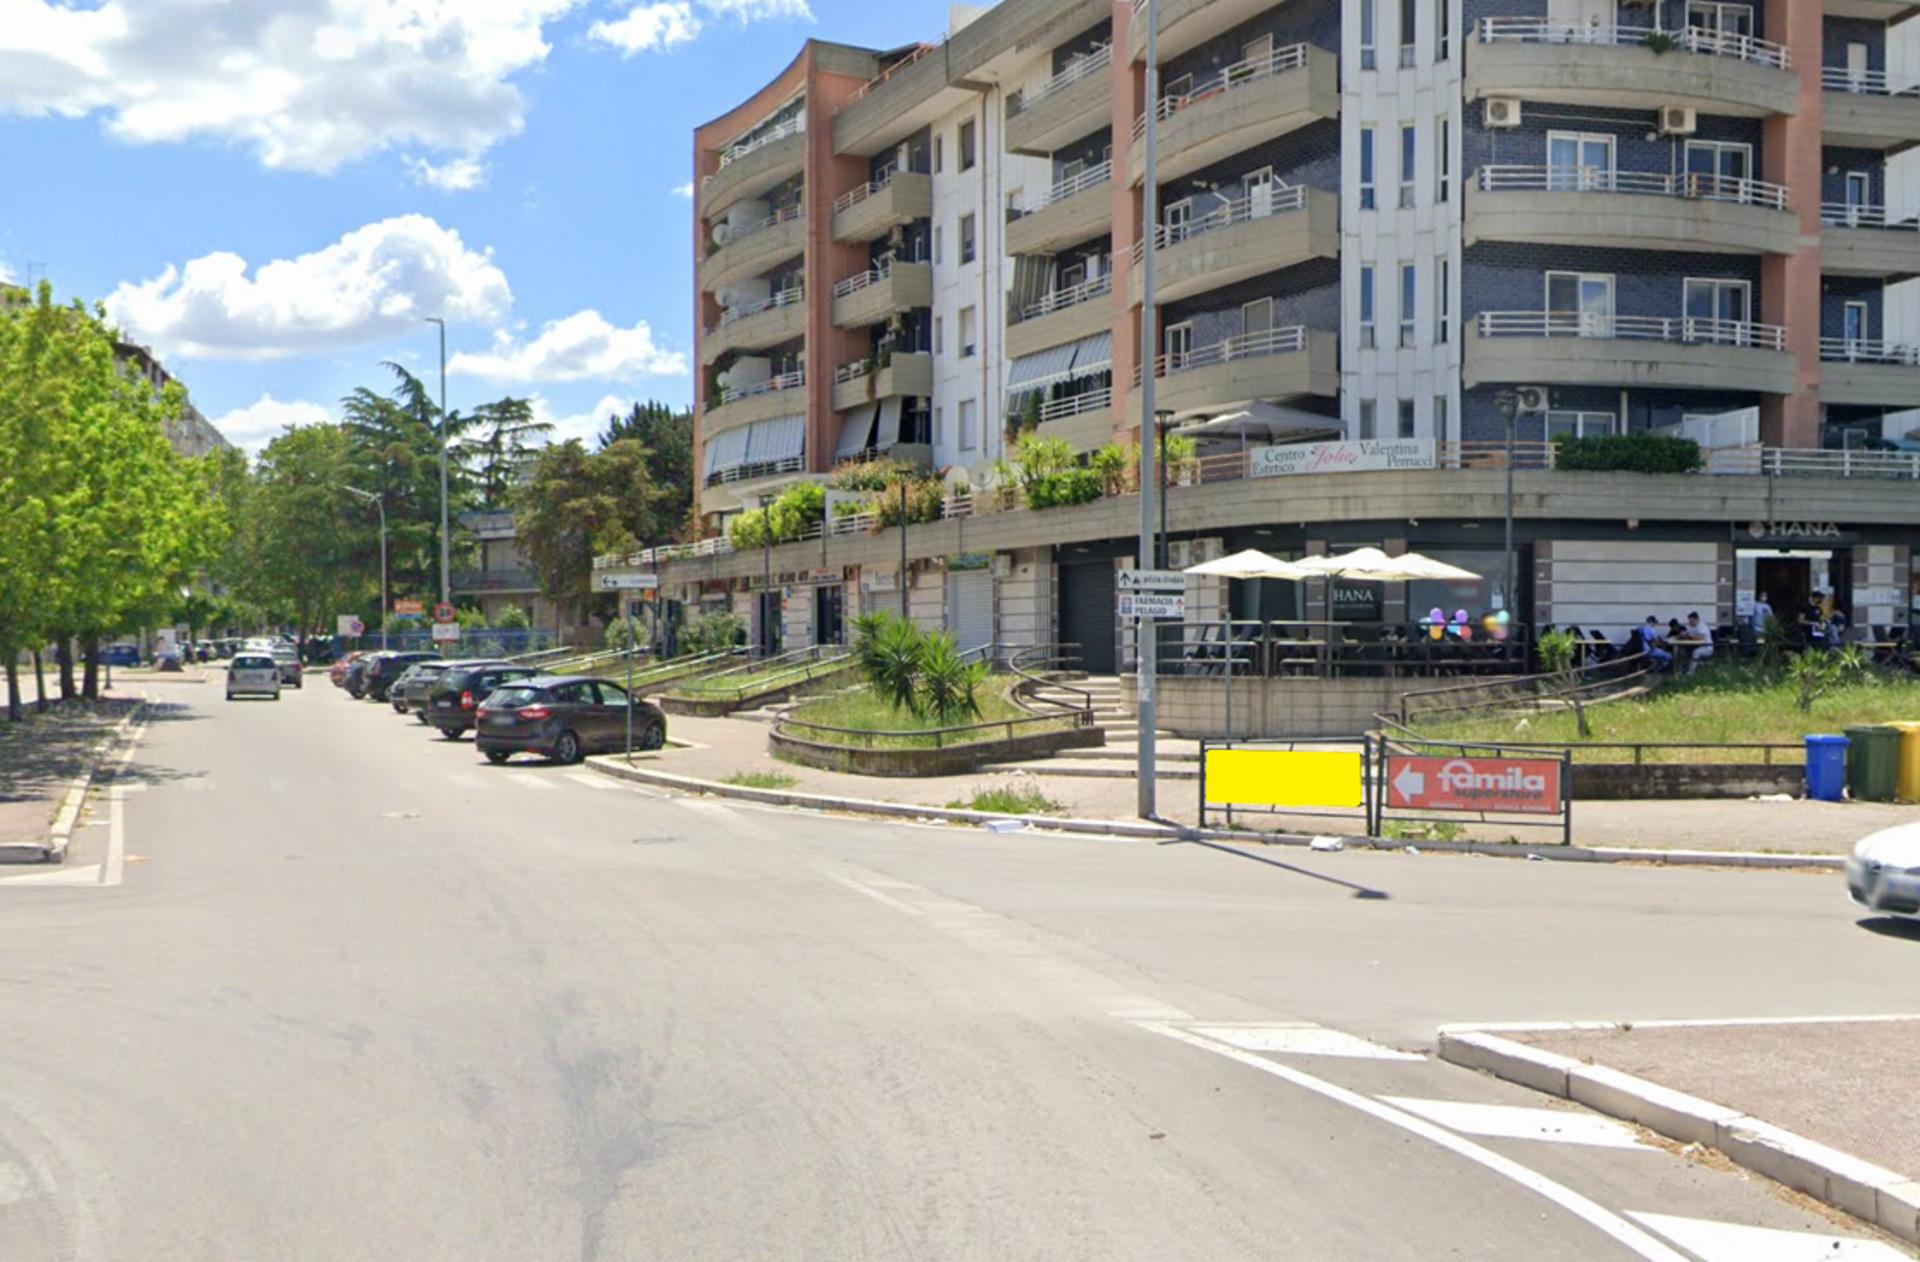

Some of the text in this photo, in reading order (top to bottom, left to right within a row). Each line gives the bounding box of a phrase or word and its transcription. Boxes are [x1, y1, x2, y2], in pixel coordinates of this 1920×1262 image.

[1265, 448, 1306, 463] Centro
[1360, 441, 1419, 456] Valentina
[1252, 462, 1295, 475] Estetico
[1135, 597, 1173, 606] FARMACIA
[1333, 589, 1374, 601] HANA
[1437, 760, 1545, 792] famila
